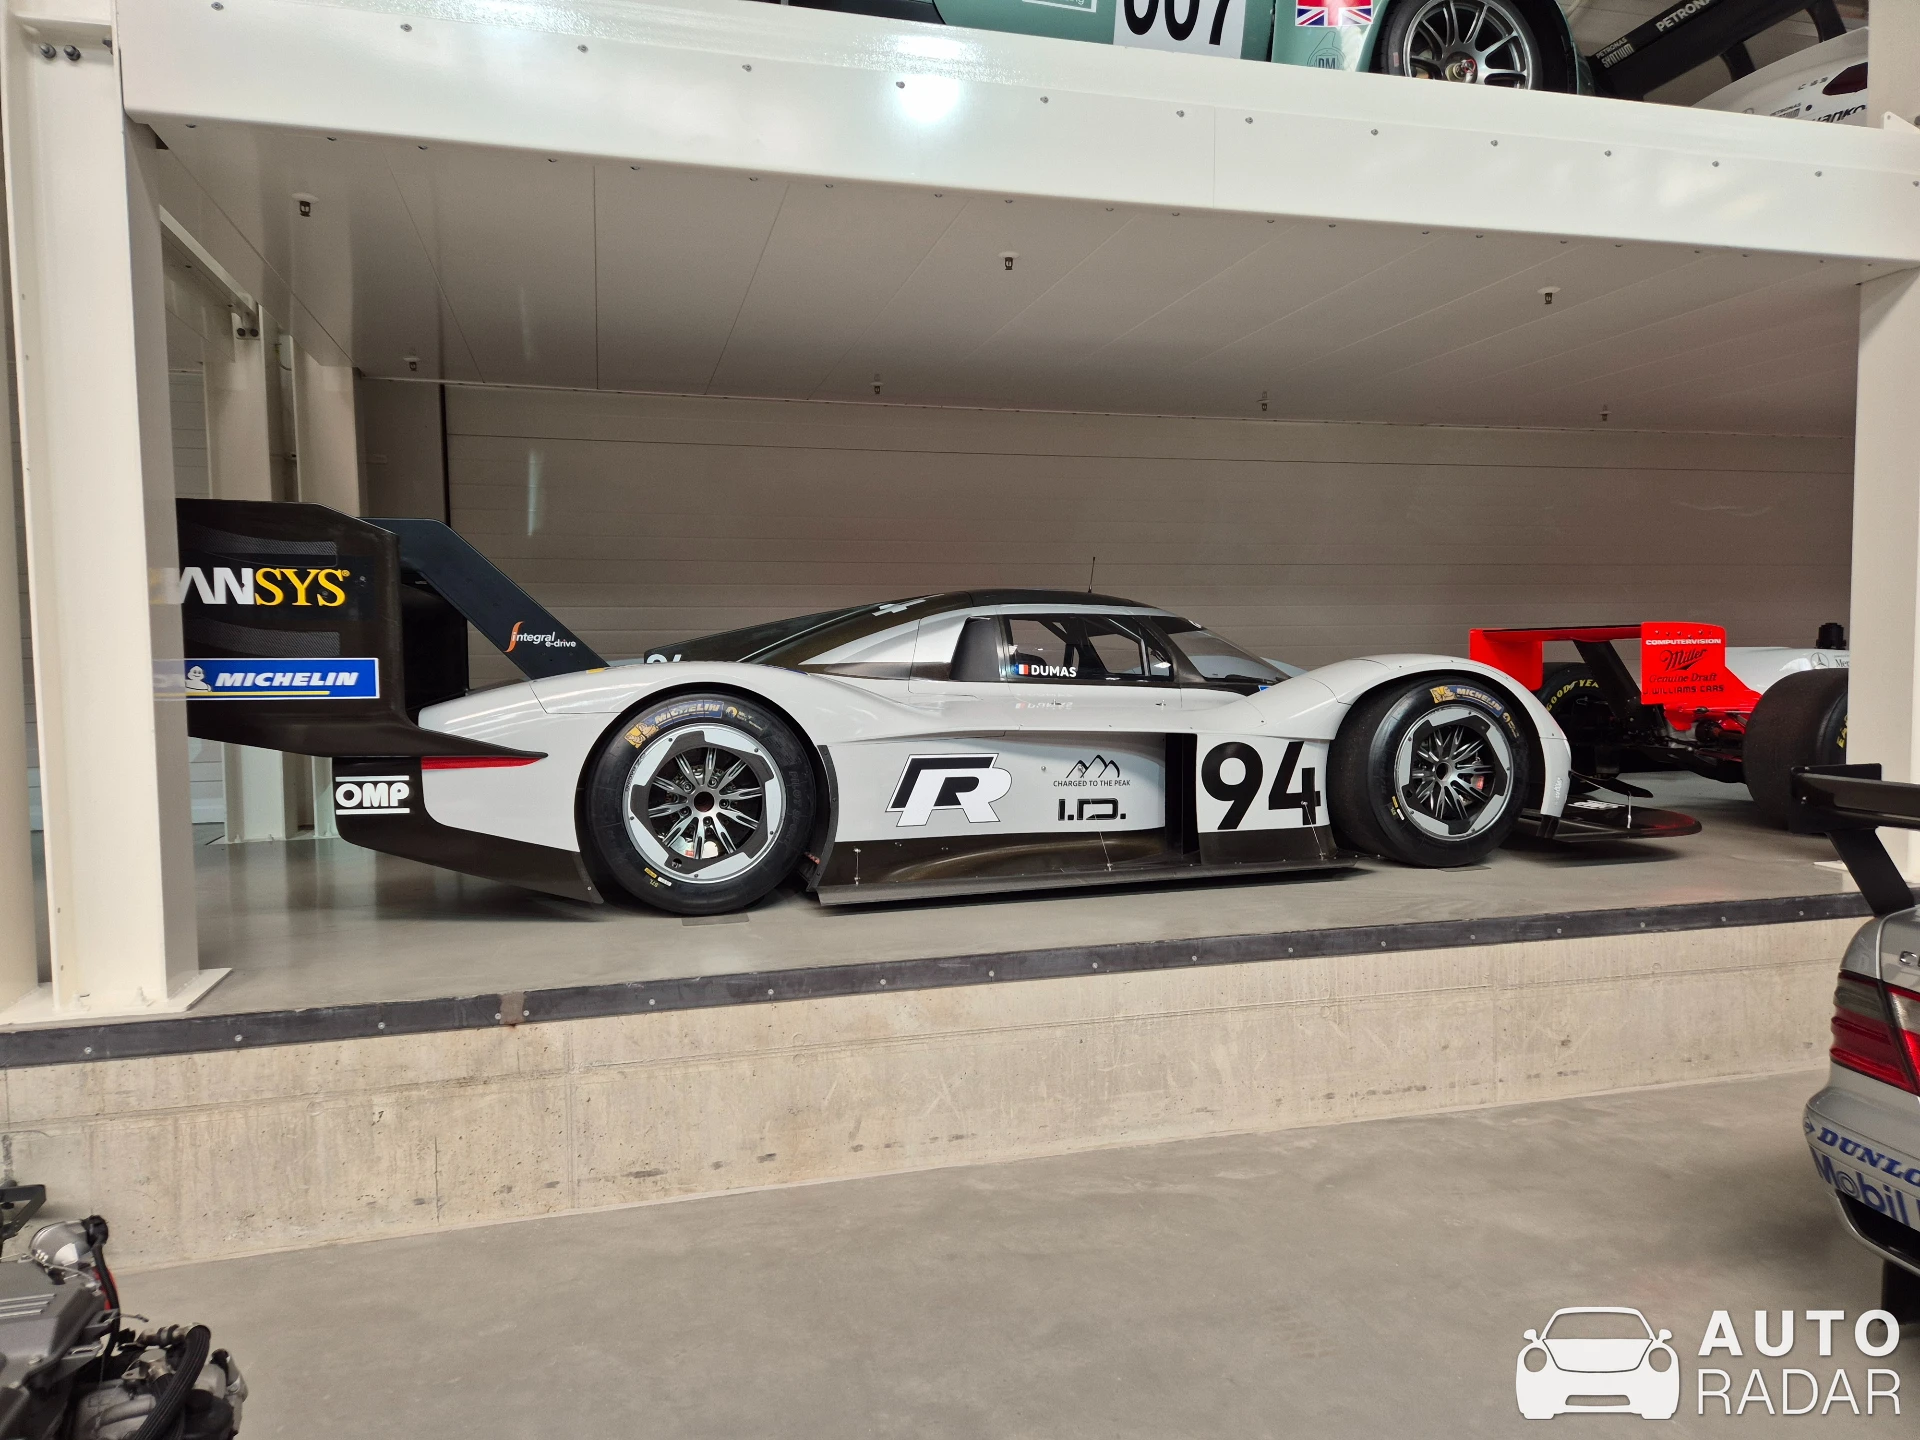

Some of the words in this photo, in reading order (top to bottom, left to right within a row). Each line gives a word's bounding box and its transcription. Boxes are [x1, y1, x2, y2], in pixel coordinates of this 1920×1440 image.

[1596, 37, 1628, 59] PETRONAS
[545, 639, 577, 648] e-drive
[1645, 638, 1722, 646] COMPUTERVISION
[1031, 664, 1077, 678] DUMAS
[1660, 648, 1708, 672] Miller
[214, 671, 359, 687] MICHELIN
[1649, 674, 1689, 683] Genuine
[1691, 672, 1718, 682] Draft
[1456, 687, 1503, 711] MICHELIN
[1546, 679, 1600, 711] GOODYEA
[1651, 685, 1697, 695] WILLIAMS
[1700, 684, 1725, 693] CARS
[884, 753, 1013, 828] R
[1114, 779, 1131, 787] PEAK
[1201, 741, 1321, 830] 94
[335, 782, 410, 808] OMP
[1810, 1144, 1911, 1227] Mobil
